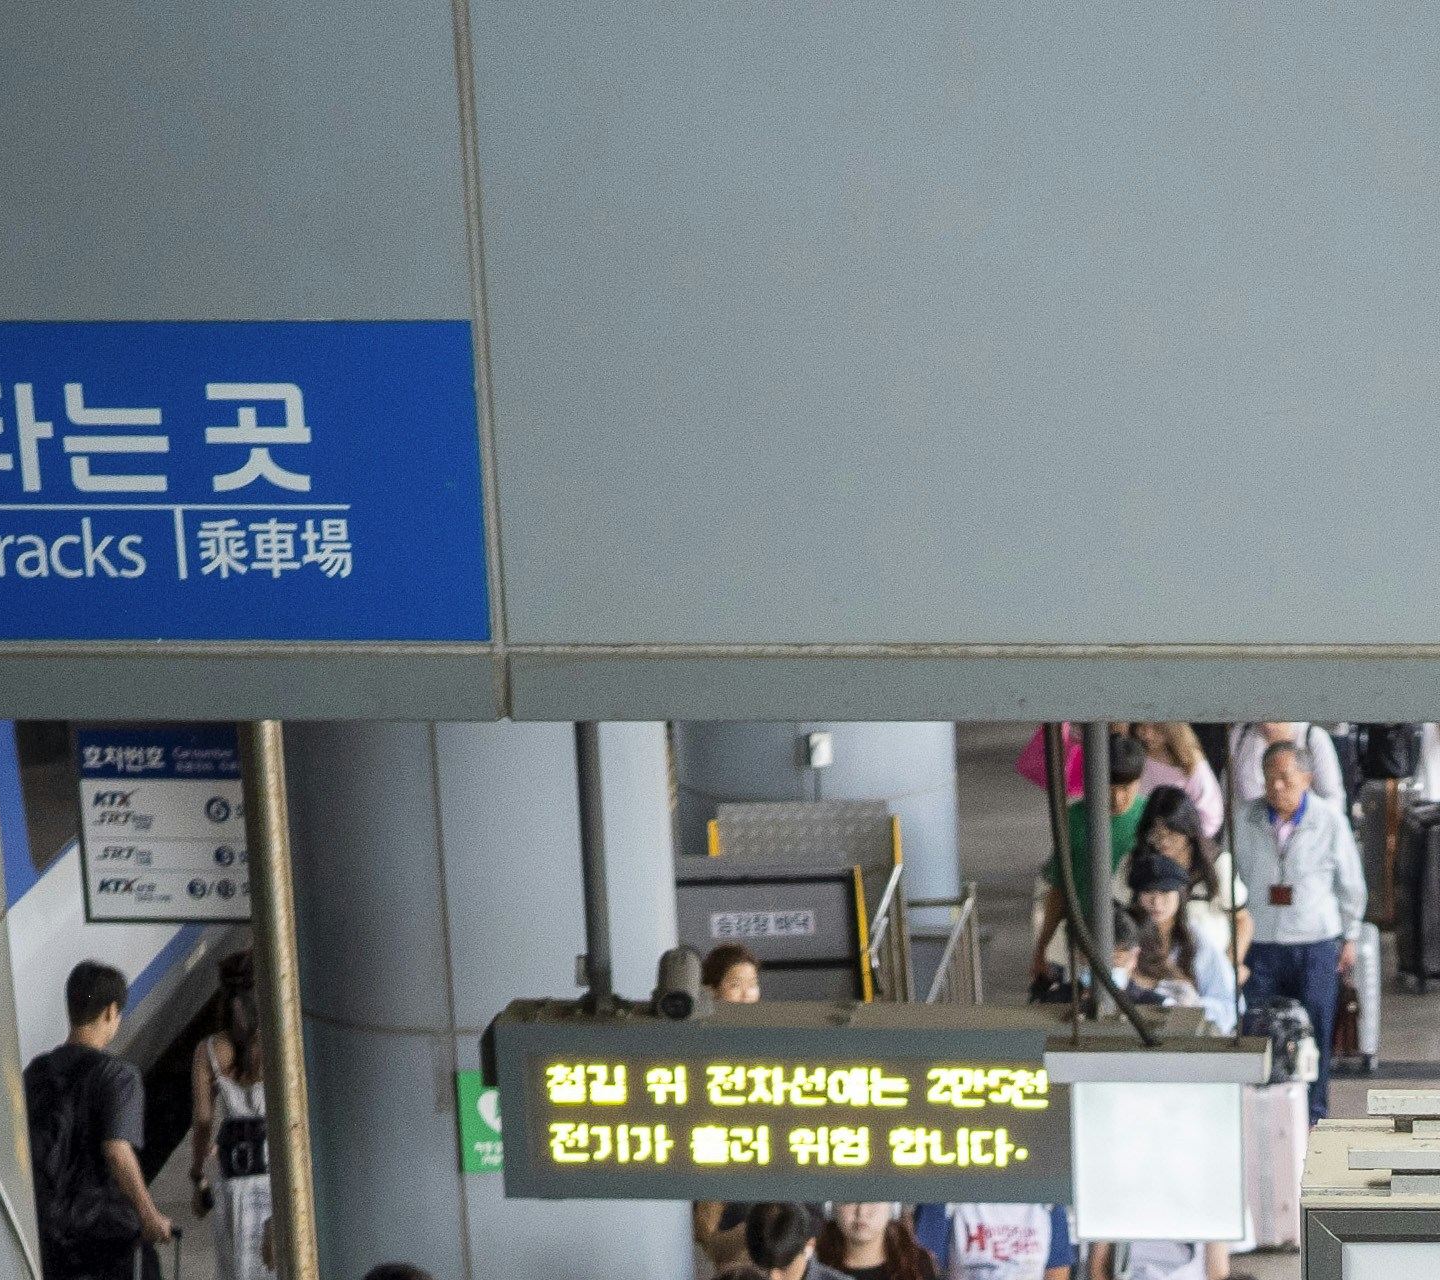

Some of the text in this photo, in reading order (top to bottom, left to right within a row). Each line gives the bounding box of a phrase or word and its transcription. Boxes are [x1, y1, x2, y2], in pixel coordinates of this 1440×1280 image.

[205, 382, 312, 492] 곳
[644, 1063, 689, 1106] 위
[704, 1063, 911, 1108] 전차선에는
[548, 1121, 675, 1165] 전기가
[786, 1124, 871, 1167] 위험
[887, 1125, 1030, 1169] 합니다.
